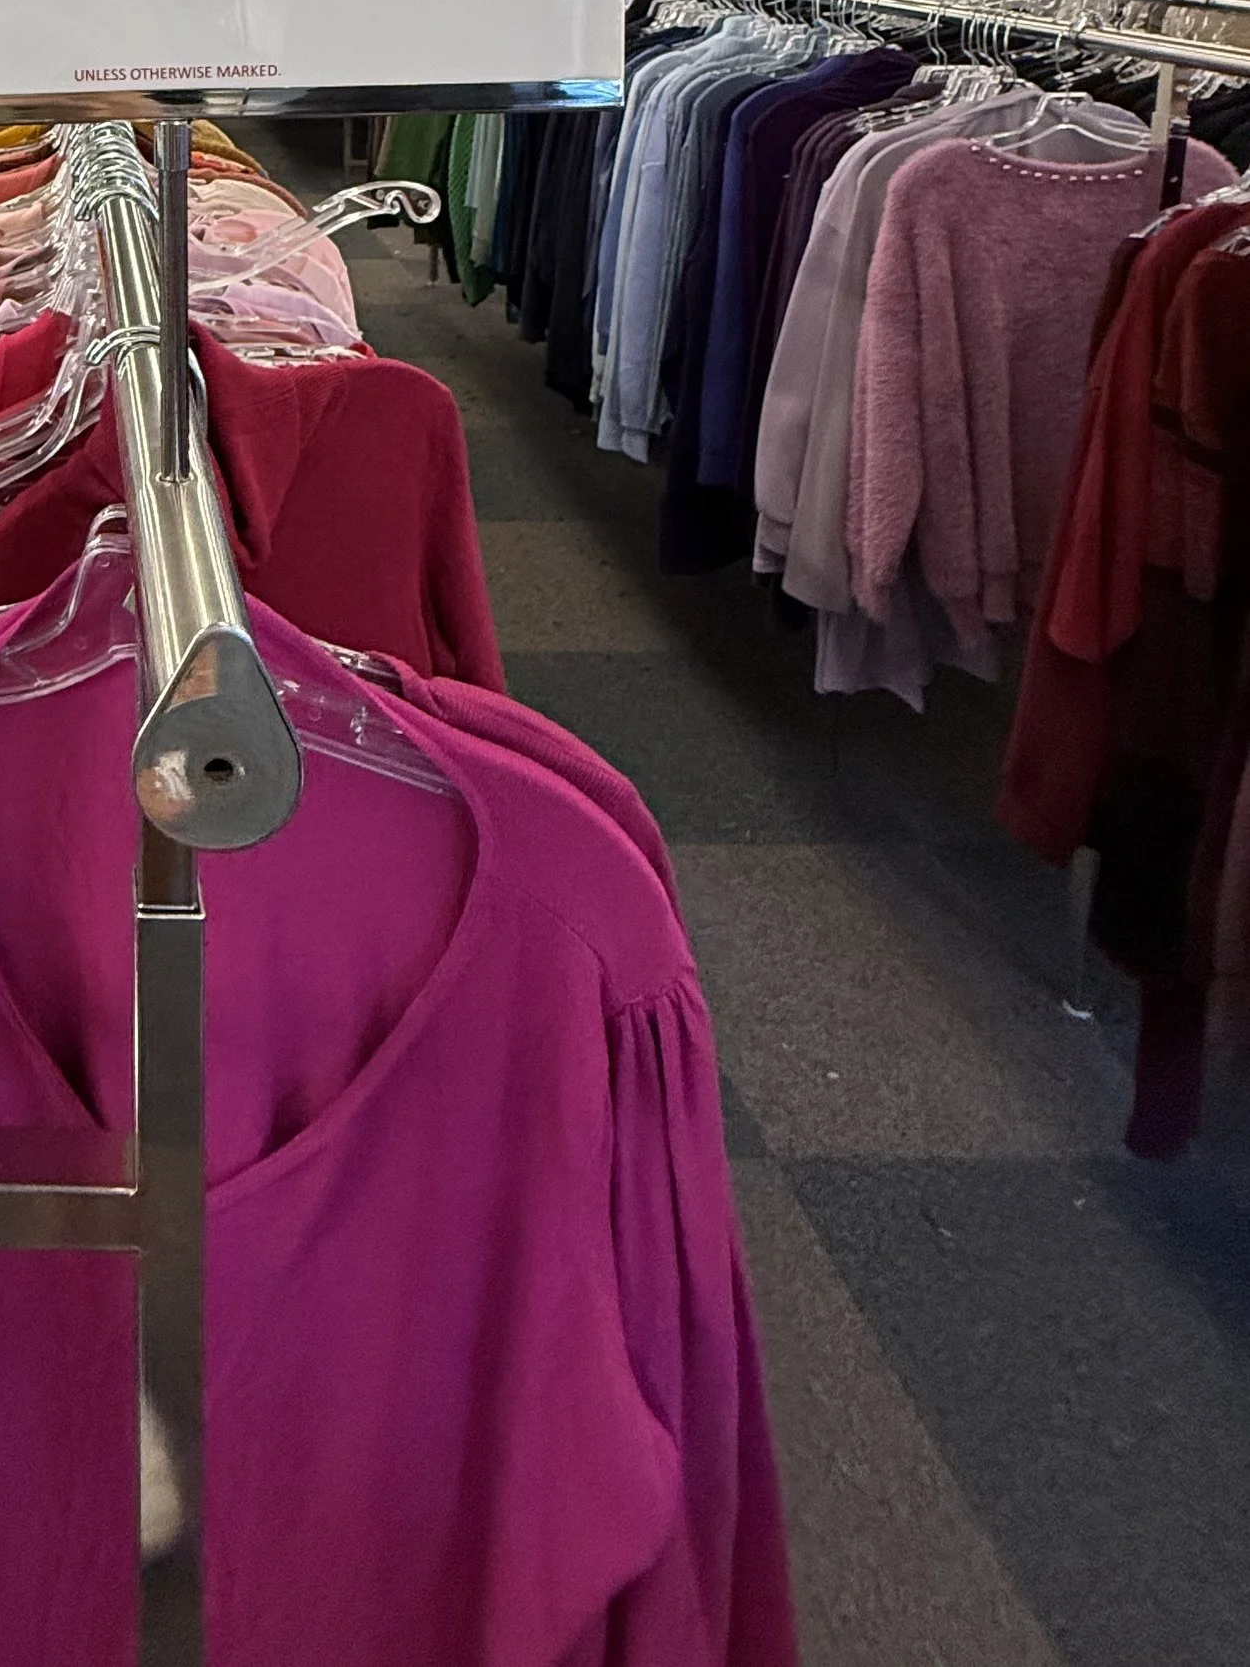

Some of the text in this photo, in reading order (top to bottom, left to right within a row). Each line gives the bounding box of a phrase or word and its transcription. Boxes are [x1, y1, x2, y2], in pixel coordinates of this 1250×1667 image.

[74, 64, 283, 82] UNLESS OTHERWISE MARKED.
